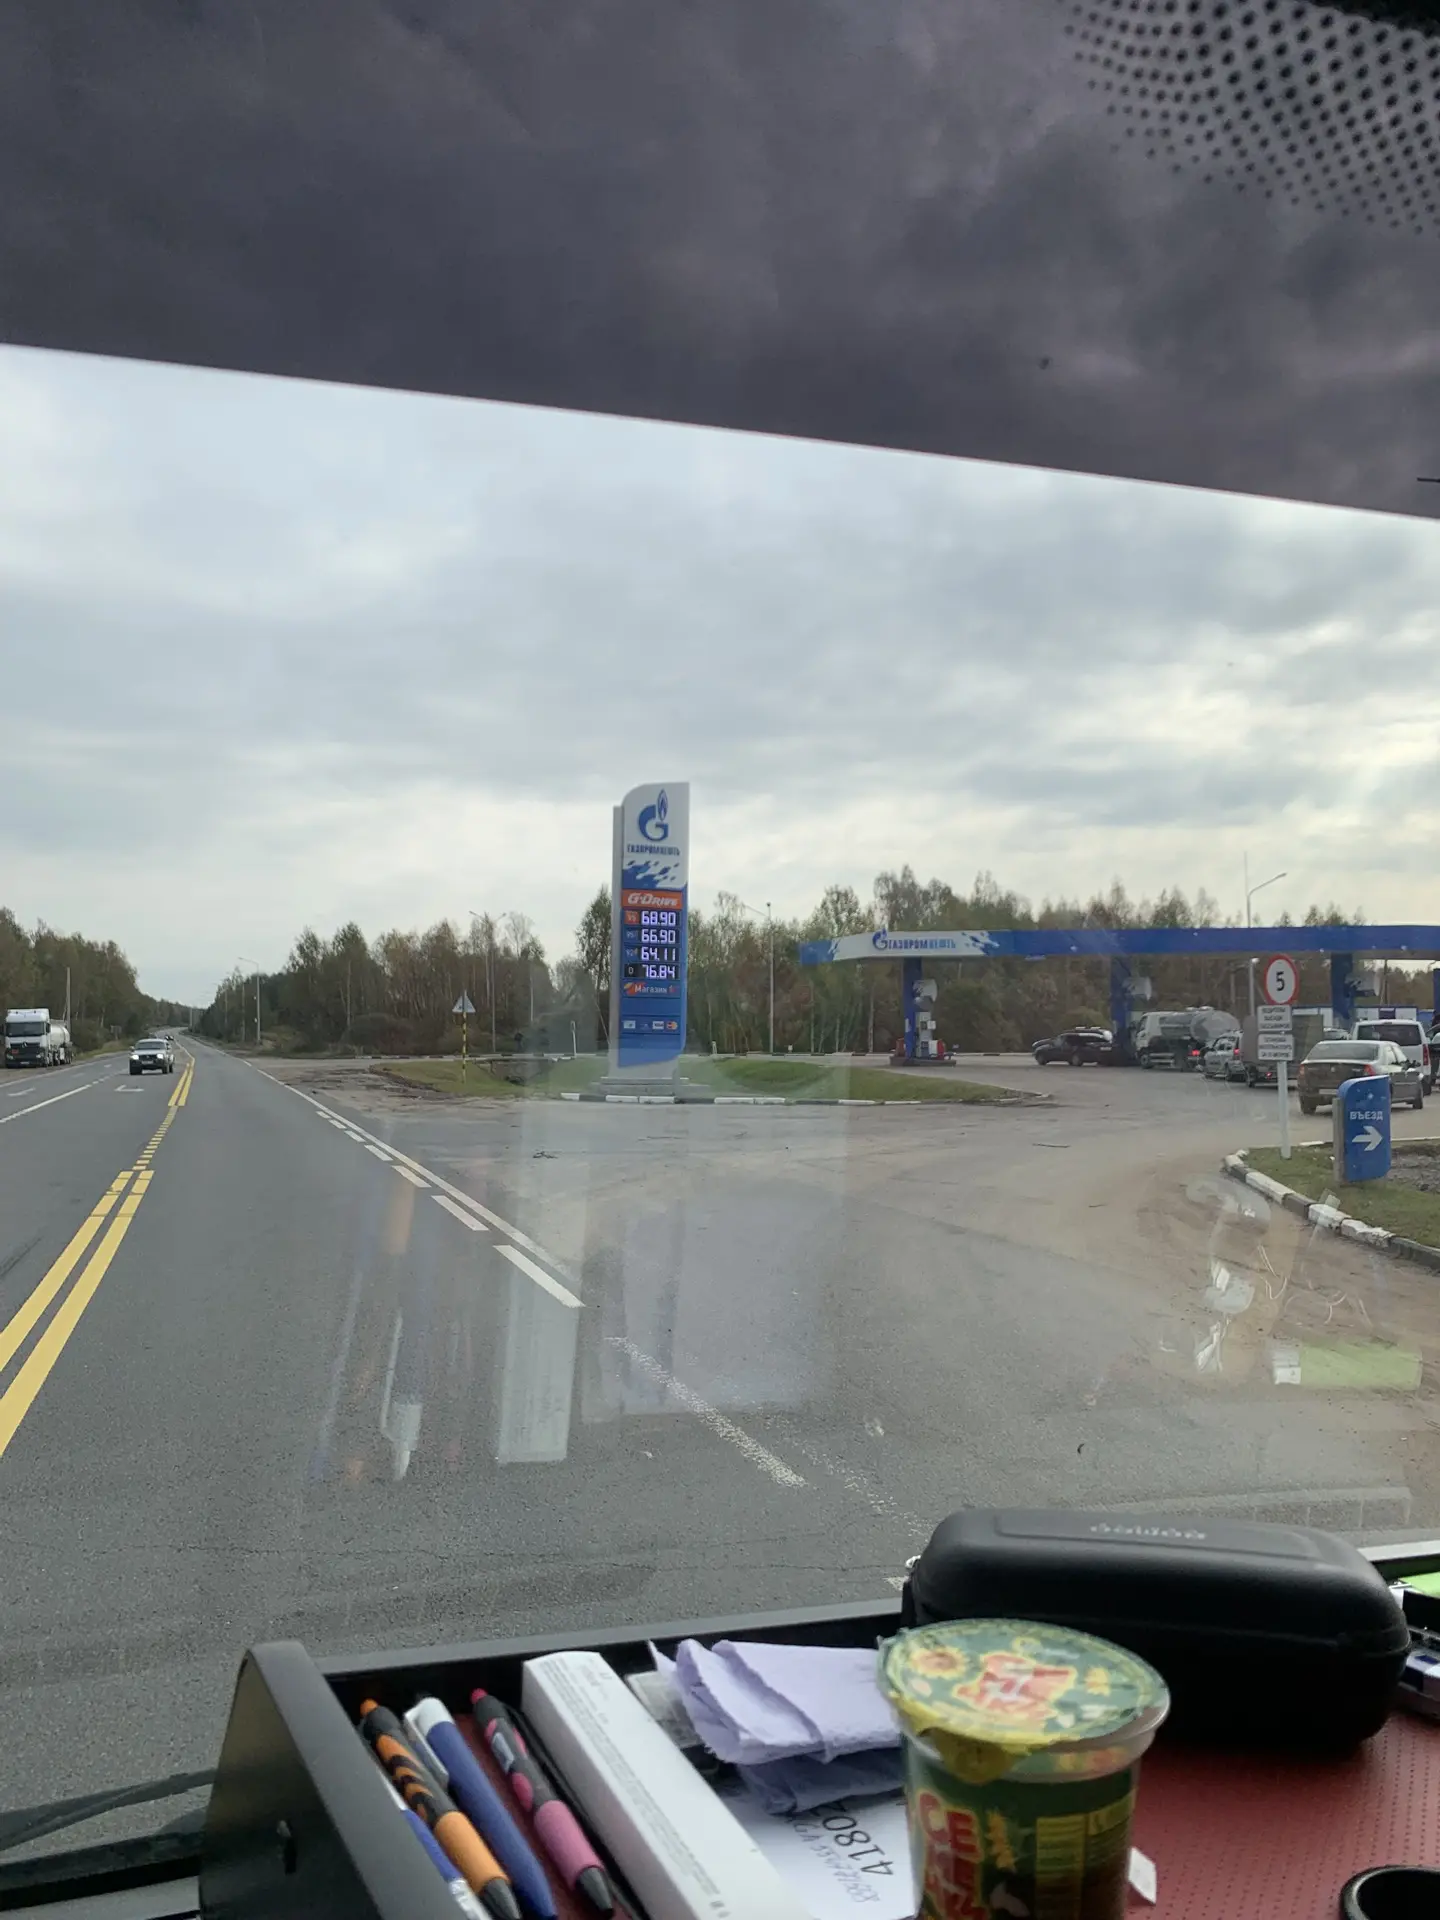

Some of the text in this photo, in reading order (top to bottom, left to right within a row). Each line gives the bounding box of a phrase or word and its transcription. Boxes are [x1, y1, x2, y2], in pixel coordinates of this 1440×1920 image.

[641, 911, 677, 926] 68.90
[641, 929, 676, 944] 66.90
[641, 946, 676, 962] 64.11
[641, 964, 676, 980] 76.84
[634, 983, 668, 994] Магазин
[1275, 971, 1285, 991] 5
[1349, 1110, 1384, 1121] ВЪЕЗД
